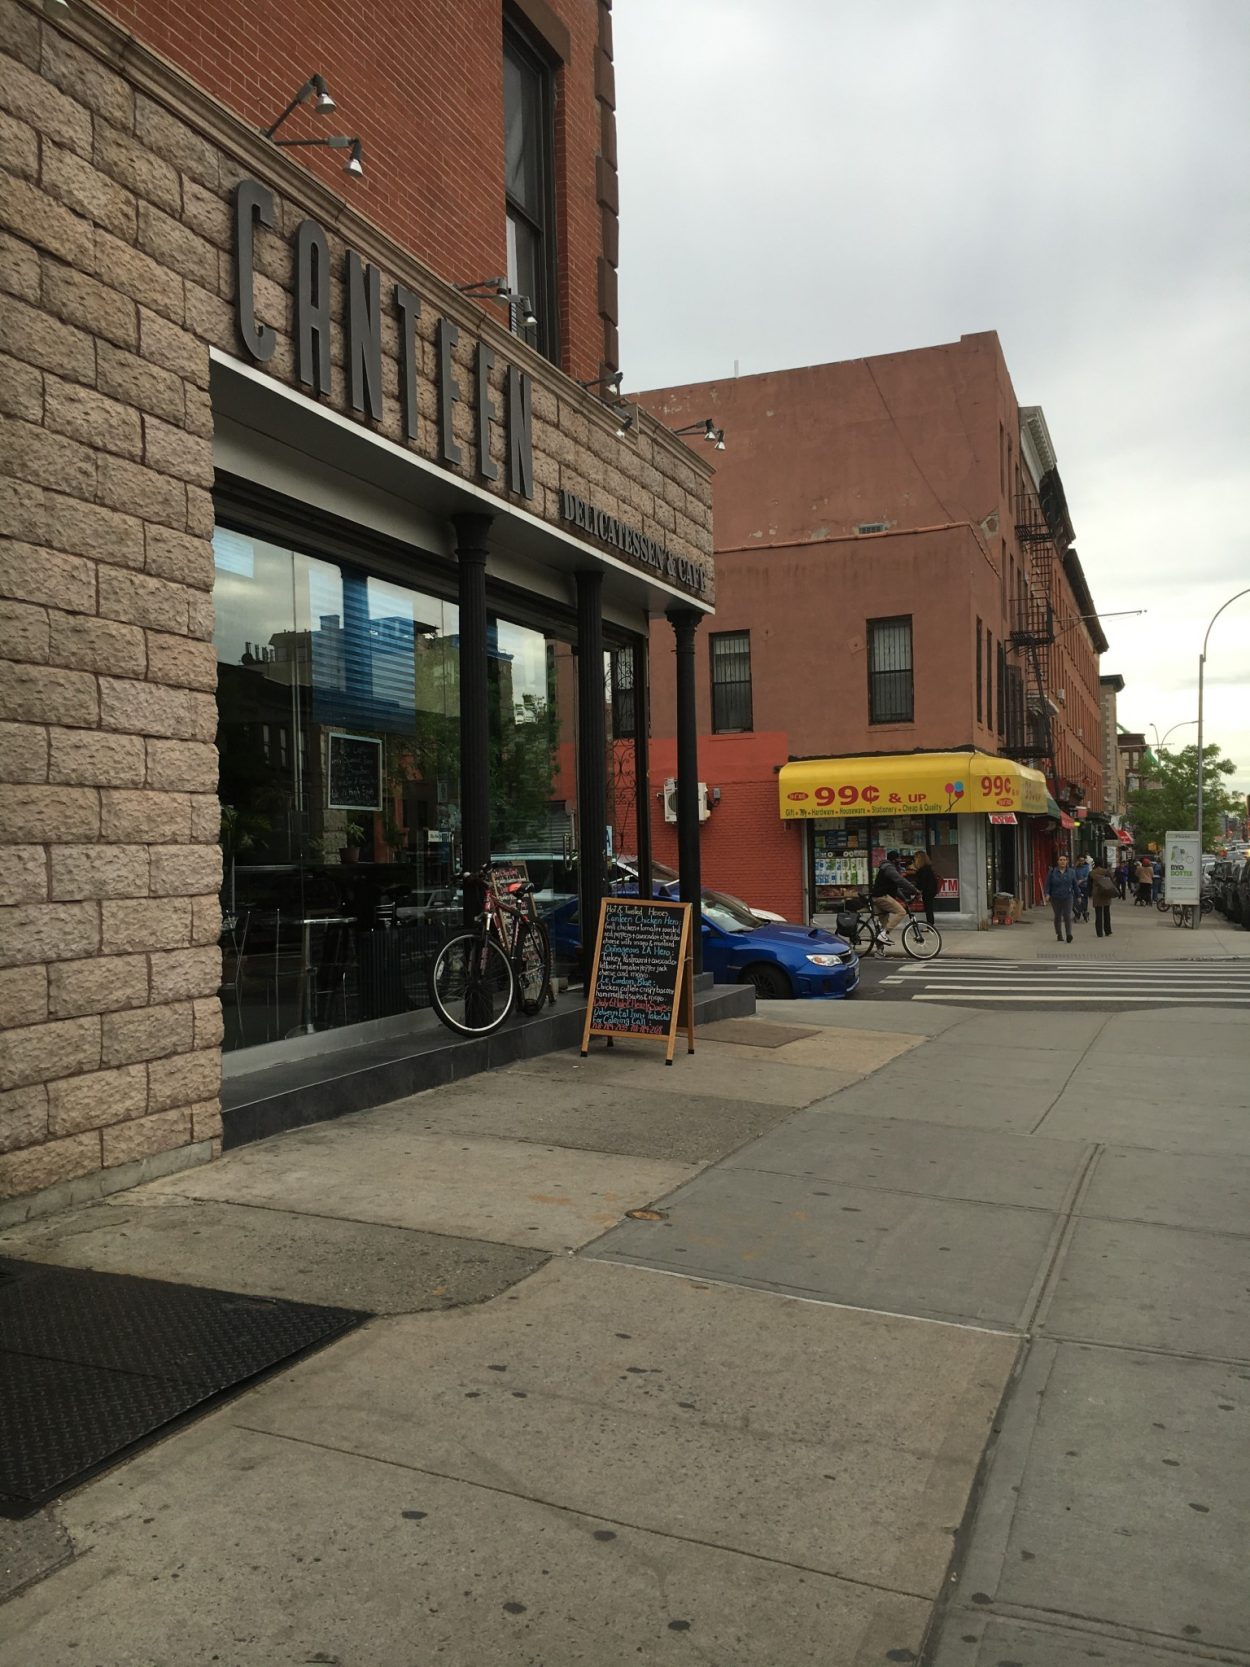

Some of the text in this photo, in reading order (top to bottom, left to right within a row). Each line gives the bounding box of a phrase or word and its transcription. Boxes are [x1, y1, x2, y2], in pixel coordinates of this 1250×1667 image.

[234, 179, 533, 499] CANTEEN
[560, 489, 665, 570] DELICATESSEN
[667, 551, 676, 577] &
[814, 785, 880, 807] 99¢
[888, 793, 902, 803] &
[908, 794, 927, 803] UP
[811, 808, 835, 816] Hardware
[839, 807, 866, 815] Houseware
[871, 805, 897, 814] Stationery
[902, 804, 919, 813] Cheap
[924, 803, 942, 812] Quality
[607, 905, 617, 913] Hot
[607, 913, 632, 922] Canteen
[635, 915, 662, 924] Chicken
